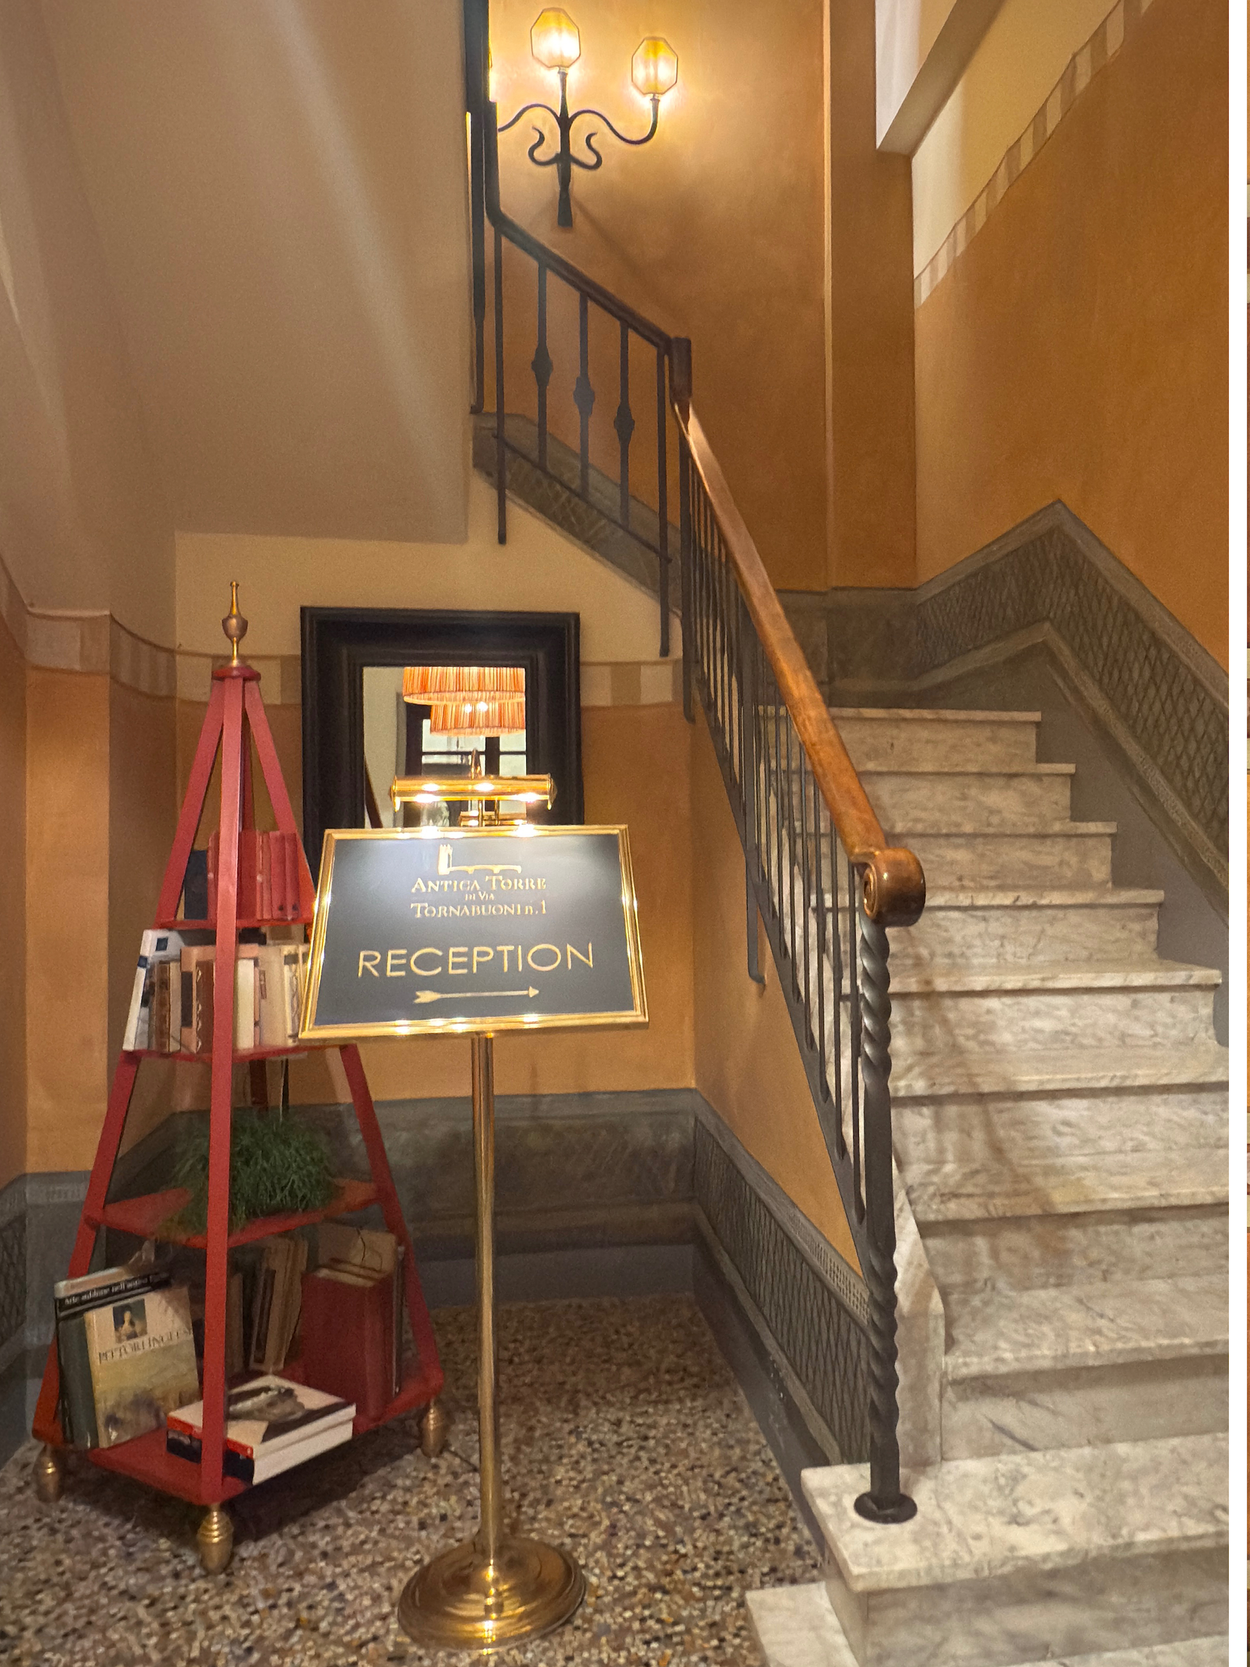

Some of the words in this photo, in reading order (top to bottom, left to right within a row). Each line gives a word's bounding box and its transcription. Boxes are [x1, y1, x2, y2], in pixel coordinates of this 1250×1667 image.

[410, 877, 481, 893] ANTICA
[485, 875, 547, 891] TORRE
[410, 902, 521, 918] TORNABUONI
[357, 942, 595, 978] RECEPTION
